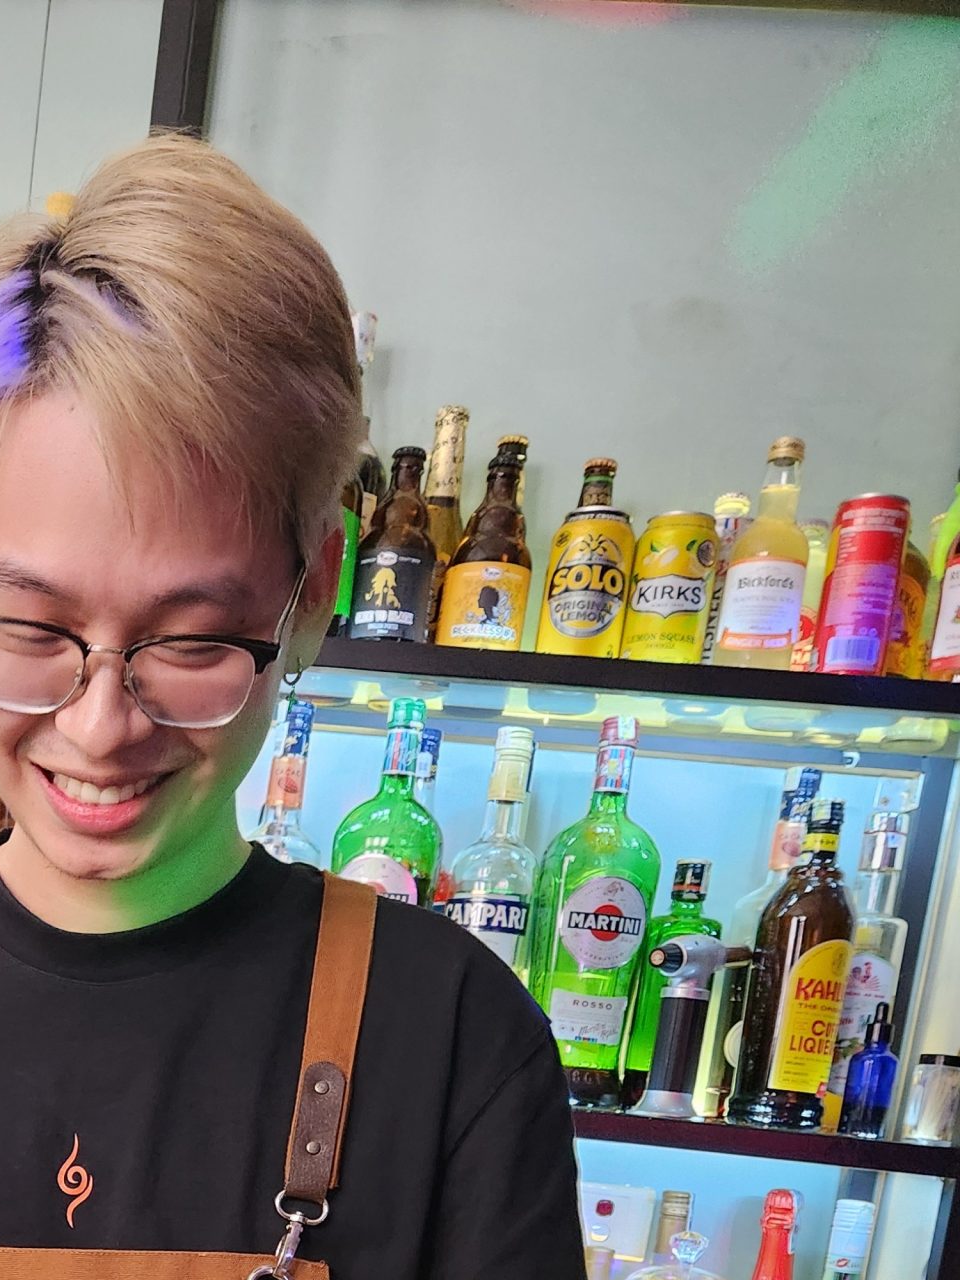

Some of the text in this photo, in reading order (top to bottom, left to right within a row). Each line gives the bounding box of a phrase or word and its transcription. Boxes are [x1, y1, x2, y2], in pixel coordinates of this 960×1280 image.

[551, 564, 624, 596] SOLO
[637, 585, 702, 605] KIRKS
[554, 599, 613, 615] ORIGINAL
[559, 610, 606, 624] LEMON
[445, 901, 528, 931] CAMPARI
[569, 911, 640, 936] MARTINI
[572, 998, 613, 1011] ROSSO
[790, 1034, 833, 1056] LIQUE
